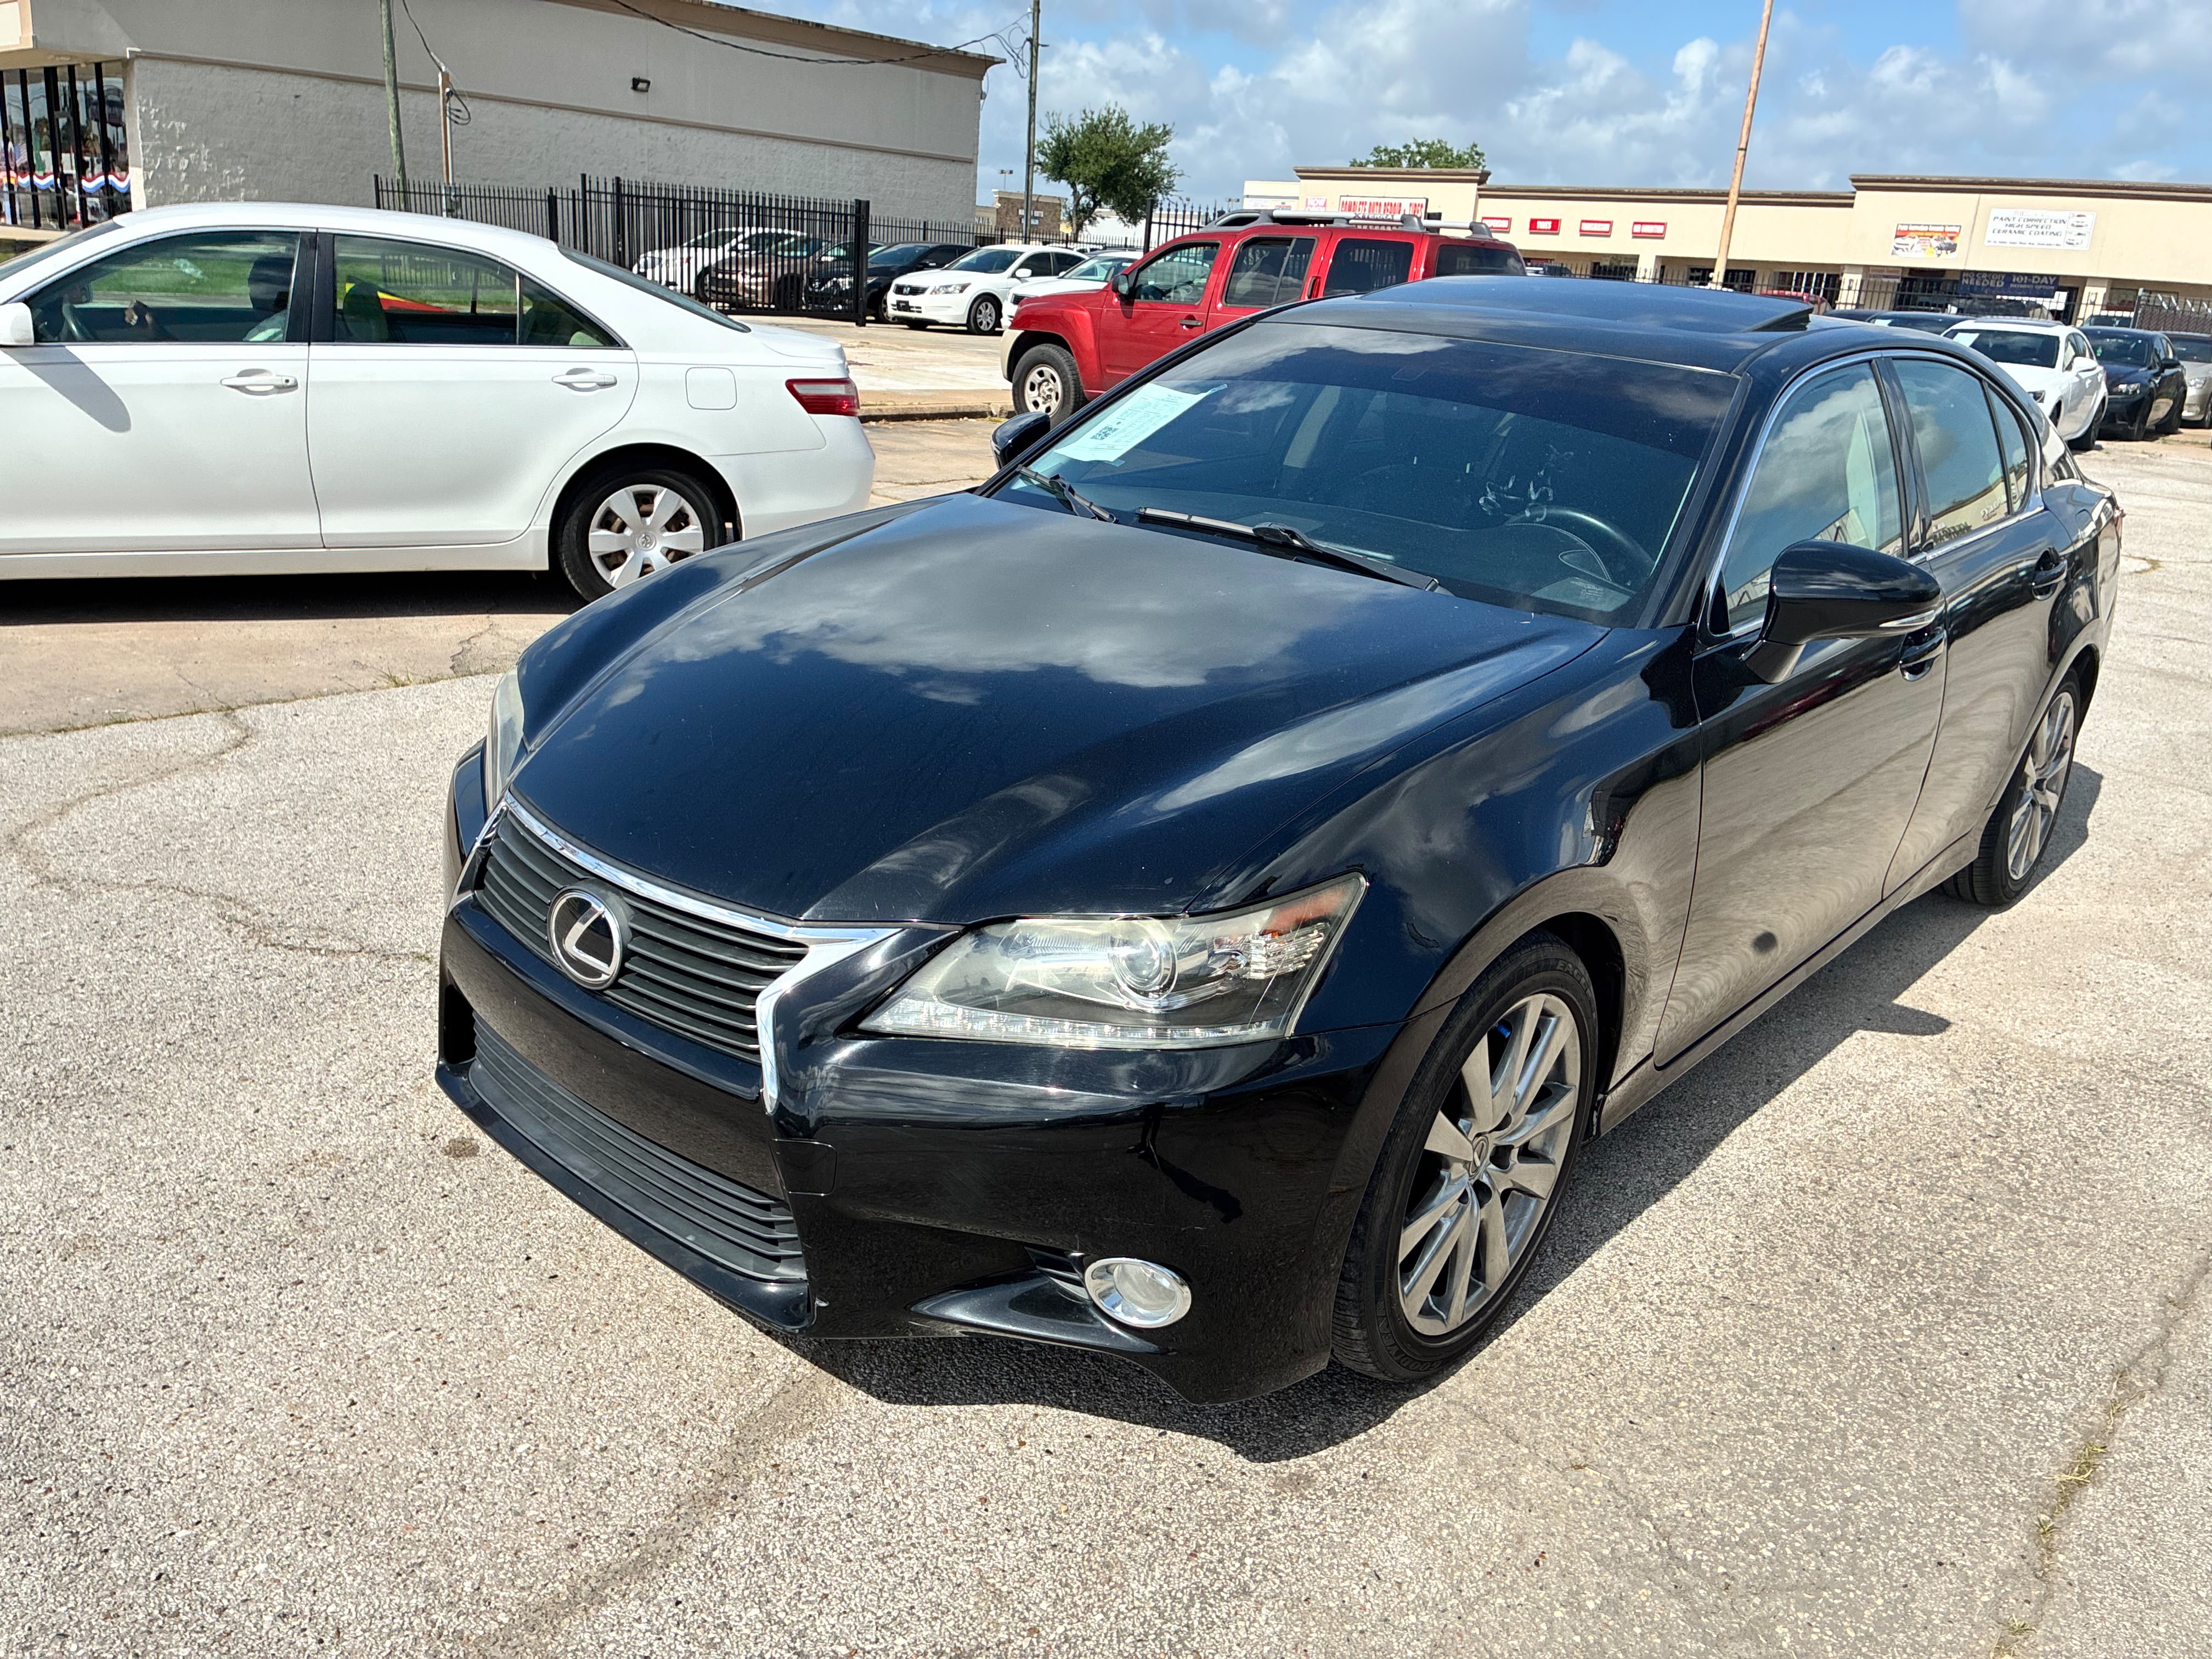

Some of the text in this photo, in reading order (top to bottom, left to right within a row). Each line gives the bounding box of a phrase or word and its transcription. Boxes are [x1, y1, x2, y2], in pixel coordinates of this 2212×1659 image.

[1307, 198, 1326, 206] NOW
[1961, 278, 2005, 288] NEEDED
[2012, 274, 2057, 285] 101-DAY
